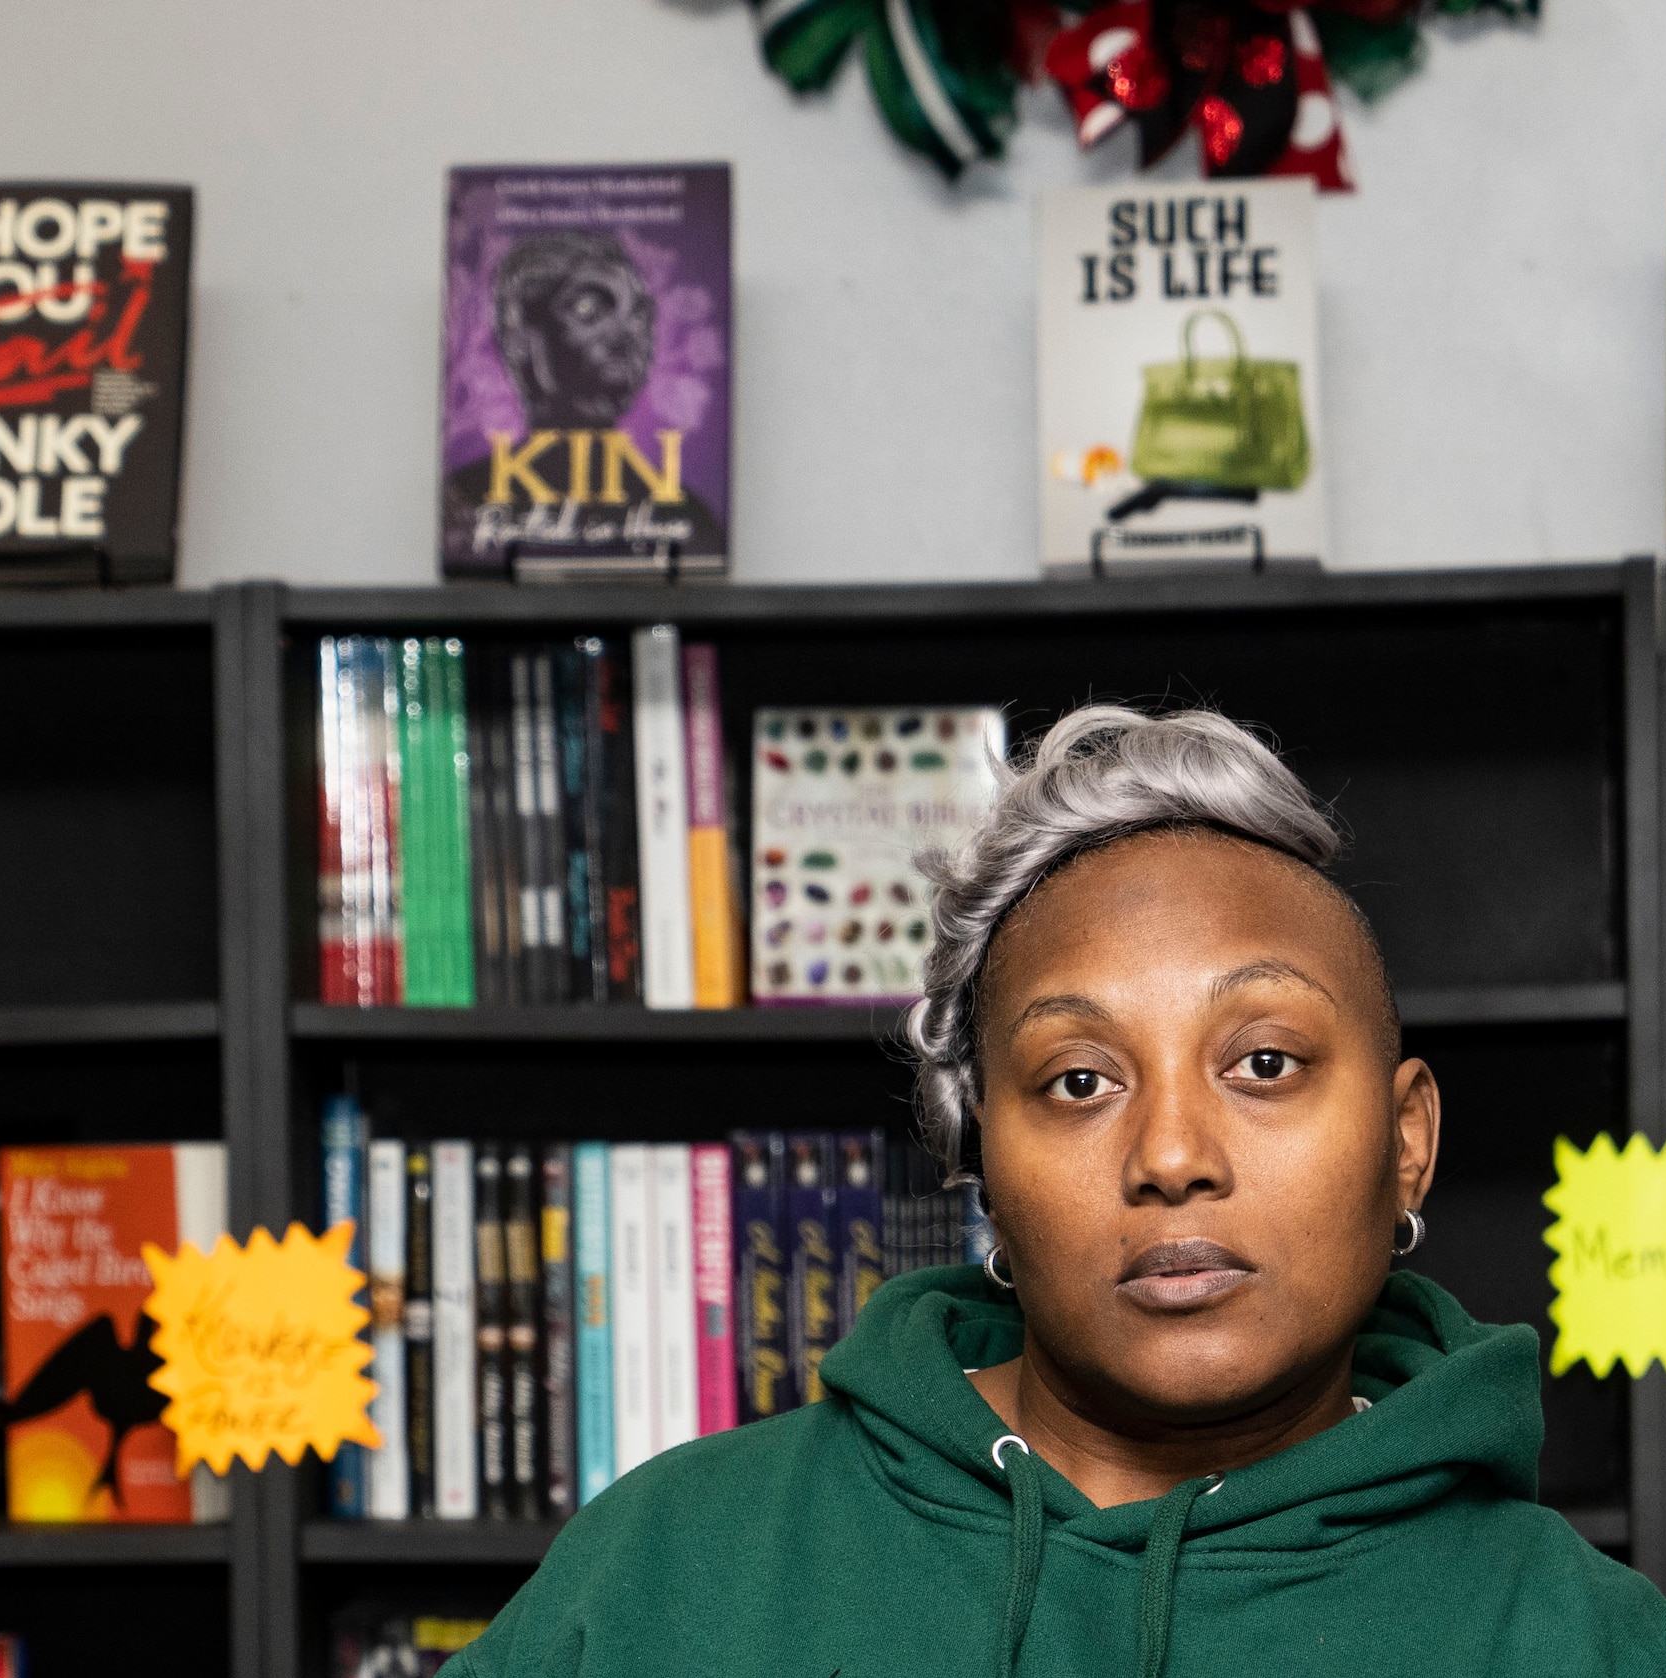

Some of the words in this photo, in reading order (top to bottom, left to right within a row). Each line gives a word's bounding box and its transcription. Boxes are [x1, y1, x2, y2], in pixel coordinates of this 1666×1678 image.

[1109, 198, 1248, 248] SUCH
[1079, 252, 1136, 303] IS
[1162, 246, 1279, 299] LIFE
[484, 428, 686, 504] KIN
